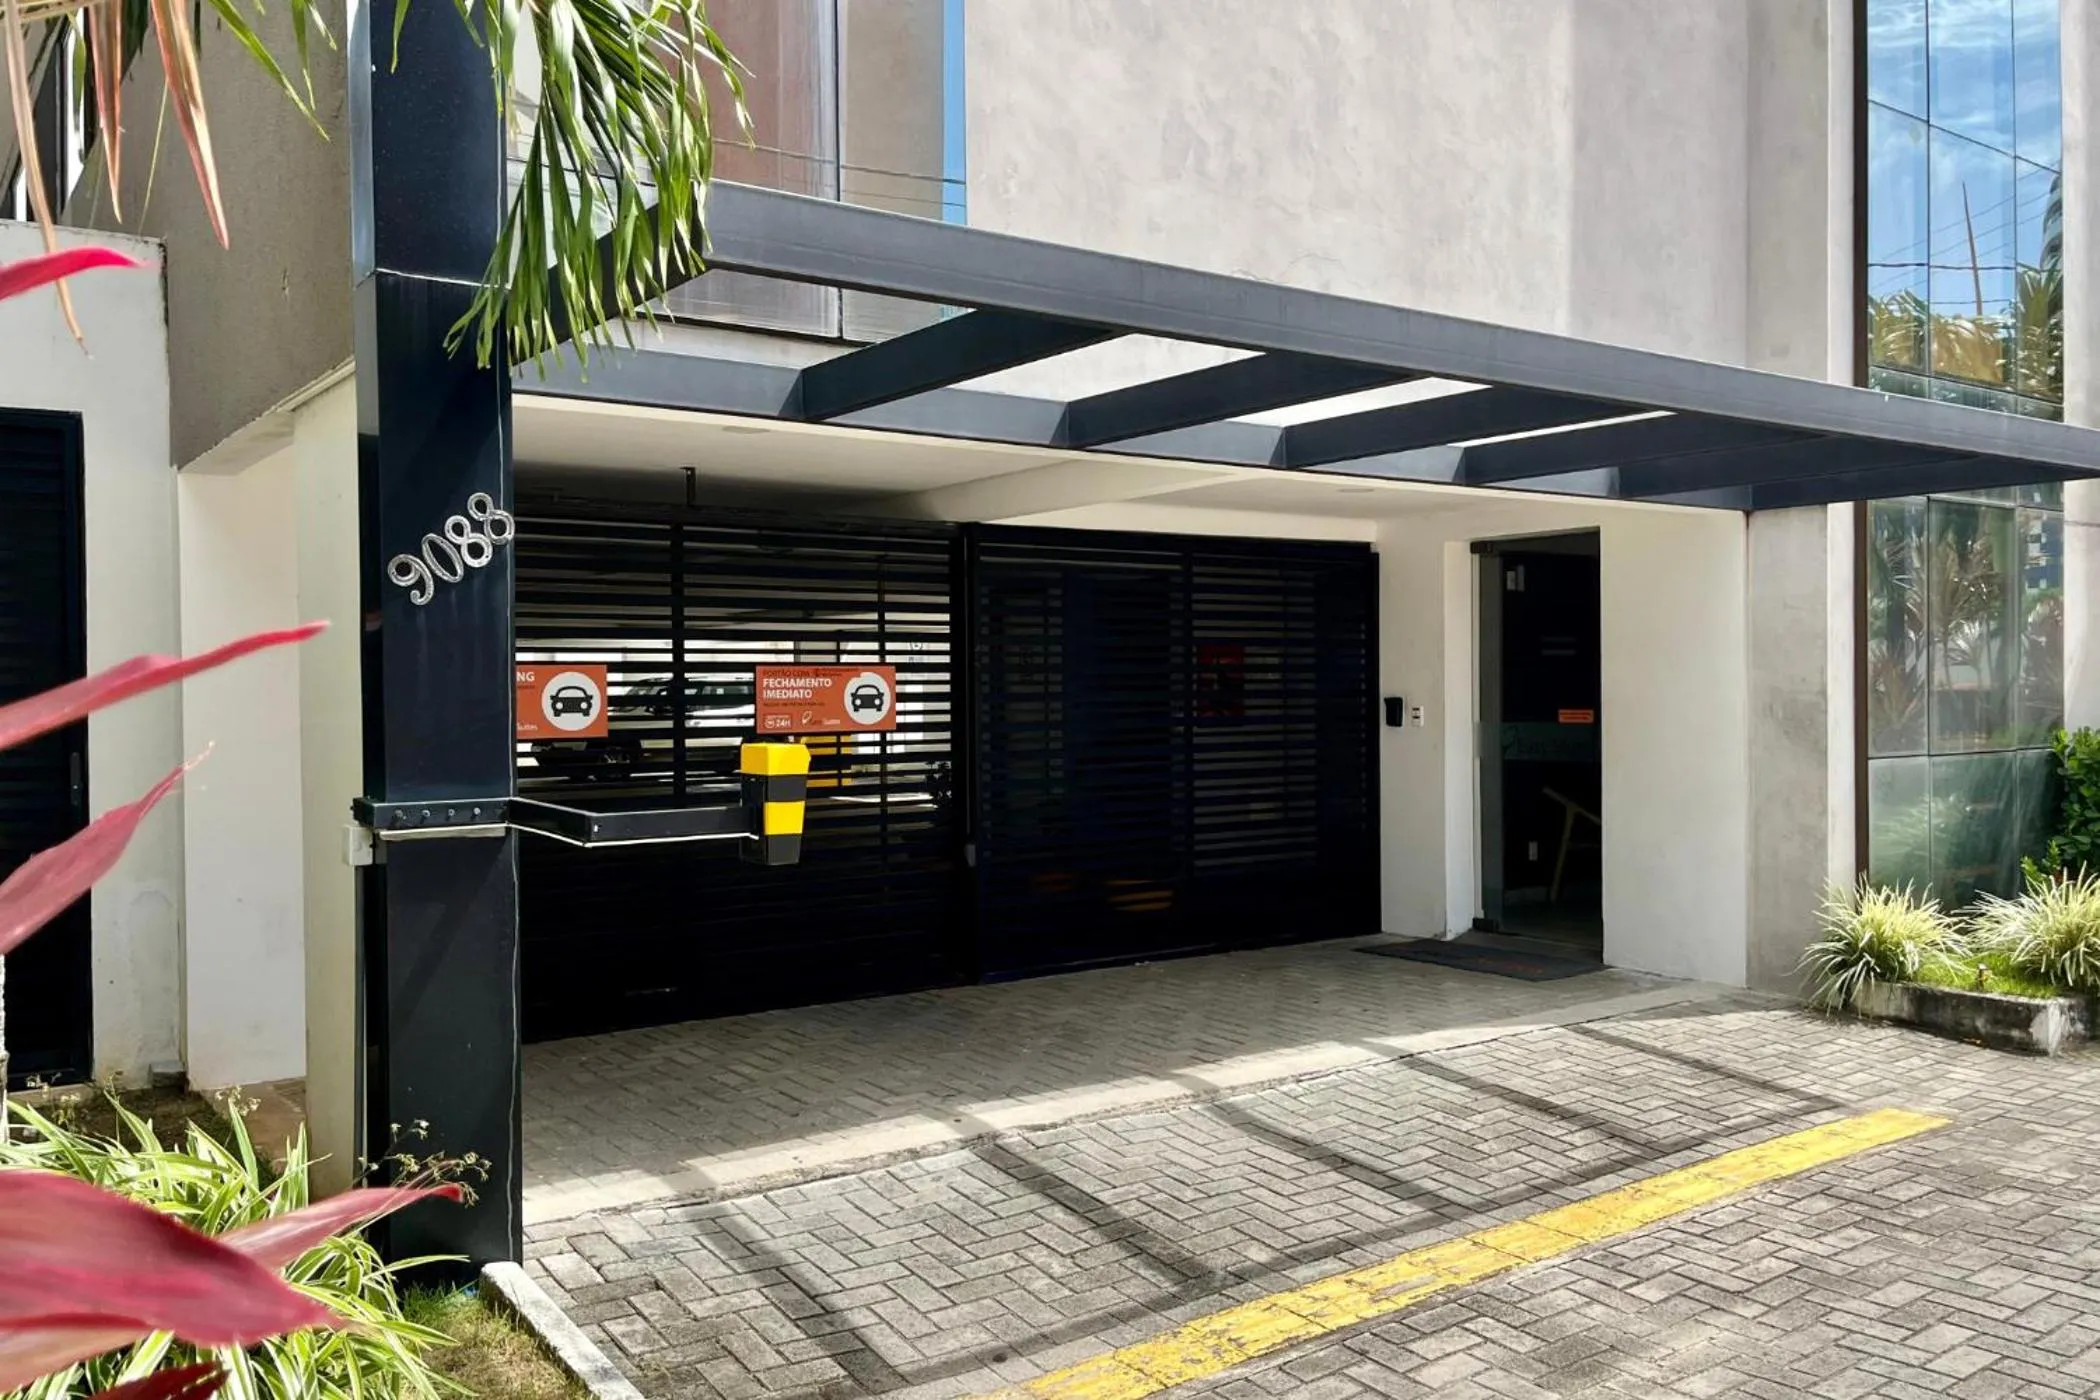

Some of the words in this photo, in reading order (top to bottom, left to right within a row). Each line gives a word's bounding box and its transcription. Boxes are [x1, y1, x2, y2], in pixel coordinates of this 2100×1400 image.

[387, 492, 515, 605] 9088
[763, 678, 832, 688] FECHAMENTO
[763, 689, 812, 699] IMEDIATO
